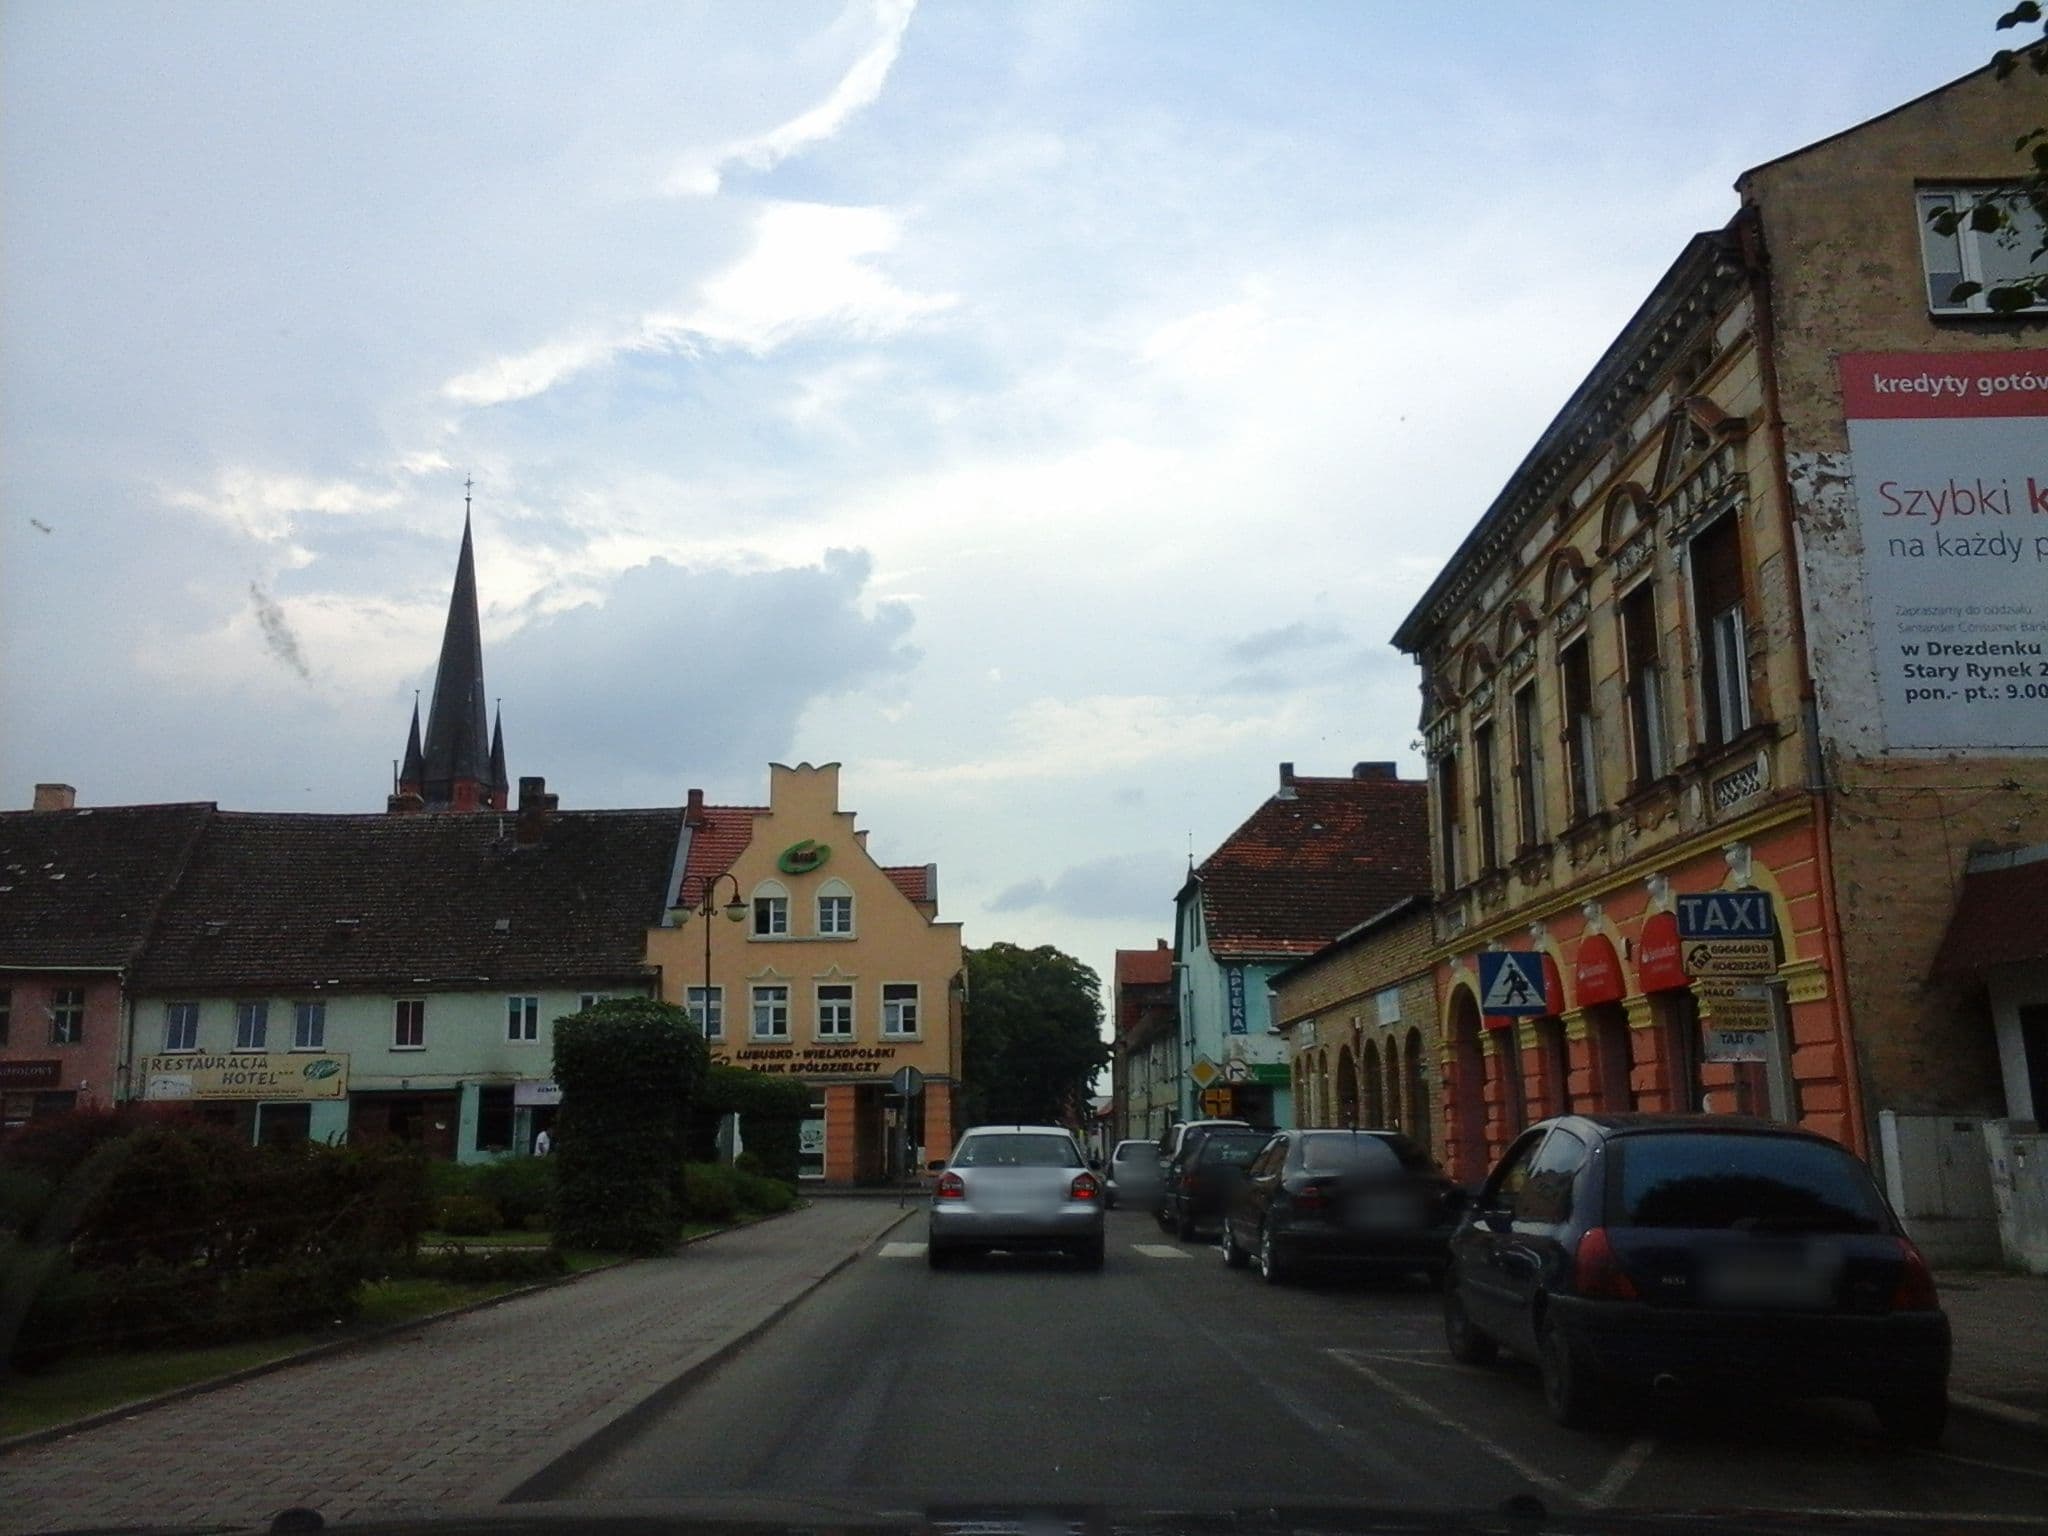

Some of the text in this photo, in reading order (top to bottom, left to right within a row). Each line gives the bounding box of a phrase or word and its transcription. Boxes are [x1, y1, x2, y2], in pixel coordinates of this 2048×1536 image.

[1873, 372, 1969, 397] kredyty
[1879, 478, 2011, 526] Szybki
[1888, 537, 1925, 558] na
[1935, 530, 2023, 563] każdy
[1901, 640, 2042, 656] w Drezdenku
[1903, 663, 1960, 682] Stary
[1966, 662, 2032, 682] Rynek
[1679, 897, 1767, 931] TAXI
[1230, 967, 1244, 1028] APTEKA
[151, 1056, 269, 1071] RESTAURACJA
[736, 1049, 793, 1060] LUBUSKO
[221, 1070, 279, 1086] HOTEL
